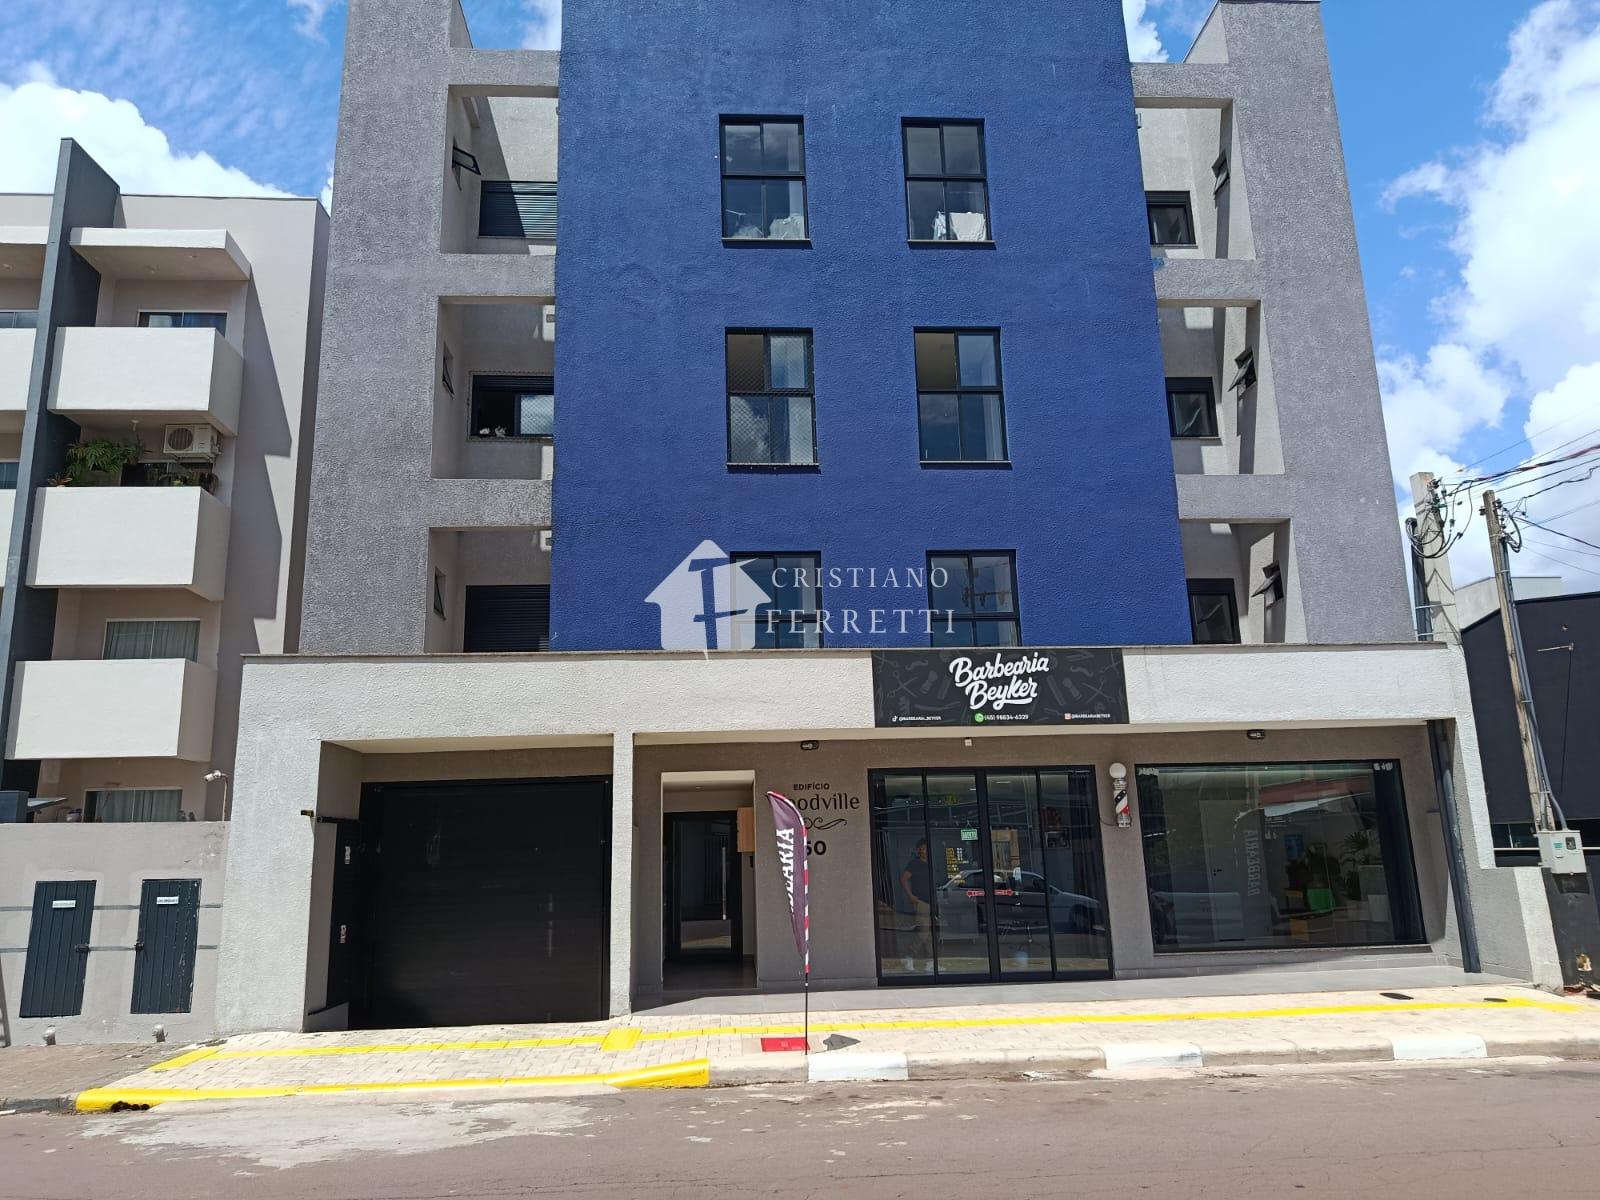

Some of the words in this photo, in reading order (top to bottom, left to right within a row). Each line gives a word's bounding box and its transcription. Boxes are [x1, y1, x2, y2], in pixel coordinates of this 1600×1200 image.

[948, 651, 1050, 687] Barbearia
[964, 676, 1038, 710] Beyker
[793, 782, 830, 791] EDIFÍCIO
